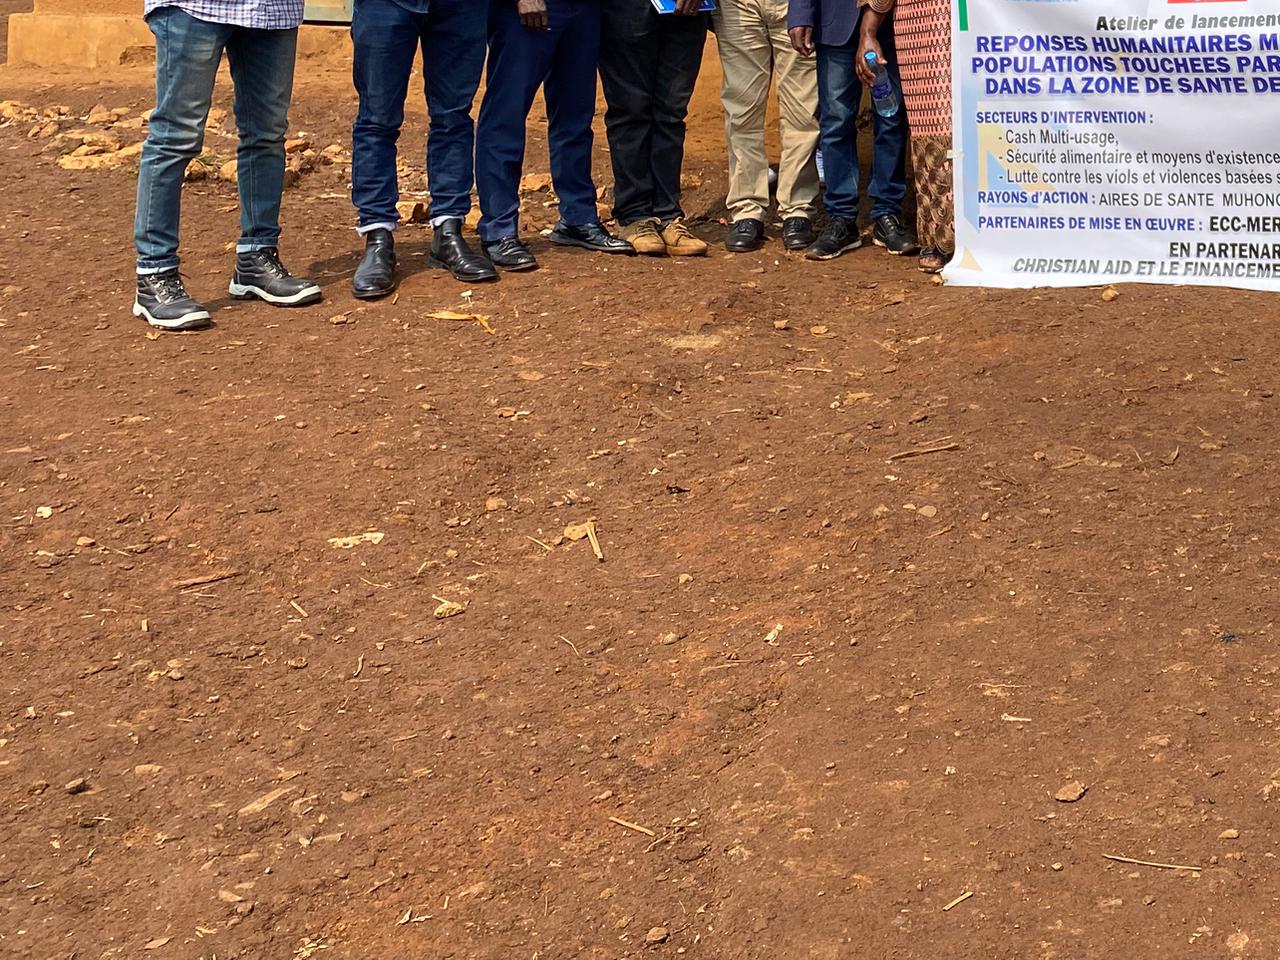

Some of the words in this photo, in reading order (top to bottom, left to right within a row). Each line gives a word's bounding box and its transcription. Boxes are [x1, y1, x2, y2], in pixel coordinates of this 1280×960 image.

[1096, 16, 1158, 31] Atelier
[1164, 15, 1185, 30] de
[976, 35, 1088, 54] REPONSES
[1092, 34, 1253, 55] HUMANITAIRES
[972, 55, 1117, 75] POPULATIONS
[1119, 56, 1231, 75] TOUCHEES
[985, 77, 1042, 95] DANS
[1049, 77, 1077, 96] LA
[1081, 76, 1139, 95] ZONE
[1145, 76, 1175, 94] DE
[1177, 76, 1246, 95] SANTE
[976, 111, 1038, 124] SECTEURS
[1041, 111, 1147, 124] D'INTERVENTION
[1005, 129, 1038, 144] Cash
[1040, 129, 1119, 146] Multi-usage,
[1006, 148, 1057, 164] Sécurité
[1060, 149, 1132, 164] alimentaire
[1136, 151, 1149, 164] et
[1151, 152, 1202, 167] moyens
[1007, 169, 1039, 183] Lutte
[1042, 170, 1082, 184] contre
[1085, 169, 1103, 184] les
[1106, 169, 1138, 184] viols
[1142, 170, 1156, 184] et
[1159, 169, 1222, 184] violences
[1225, 168, 1273, 184] basées
[977, 191, 1028, 204] RAYONS
[1031, 191, 1088, 204] d'ACTION
[1099, 193, 1139, 206] AIRES
[1143, 193, 1163, 206] DE
[1167, 193, 1214, 207] SANTE
[978, 216, 1065, 230] PARTENAIRES
[1069, 217, 1086, 230] DE
[1089, 217, 1121, 230] MISE
[1125, 217, 1142, 231] EN
[1146, 217, 1195, 231] ŒUVRE
[1169, 242, 1191, 258] EN
[1013, 258, 1100, 274] CHRISTIAN
[1102, 259, 1132, 275] AID
[1135, 260, 1156, 276] ET
[1159, 261, 1178, 276] LE
